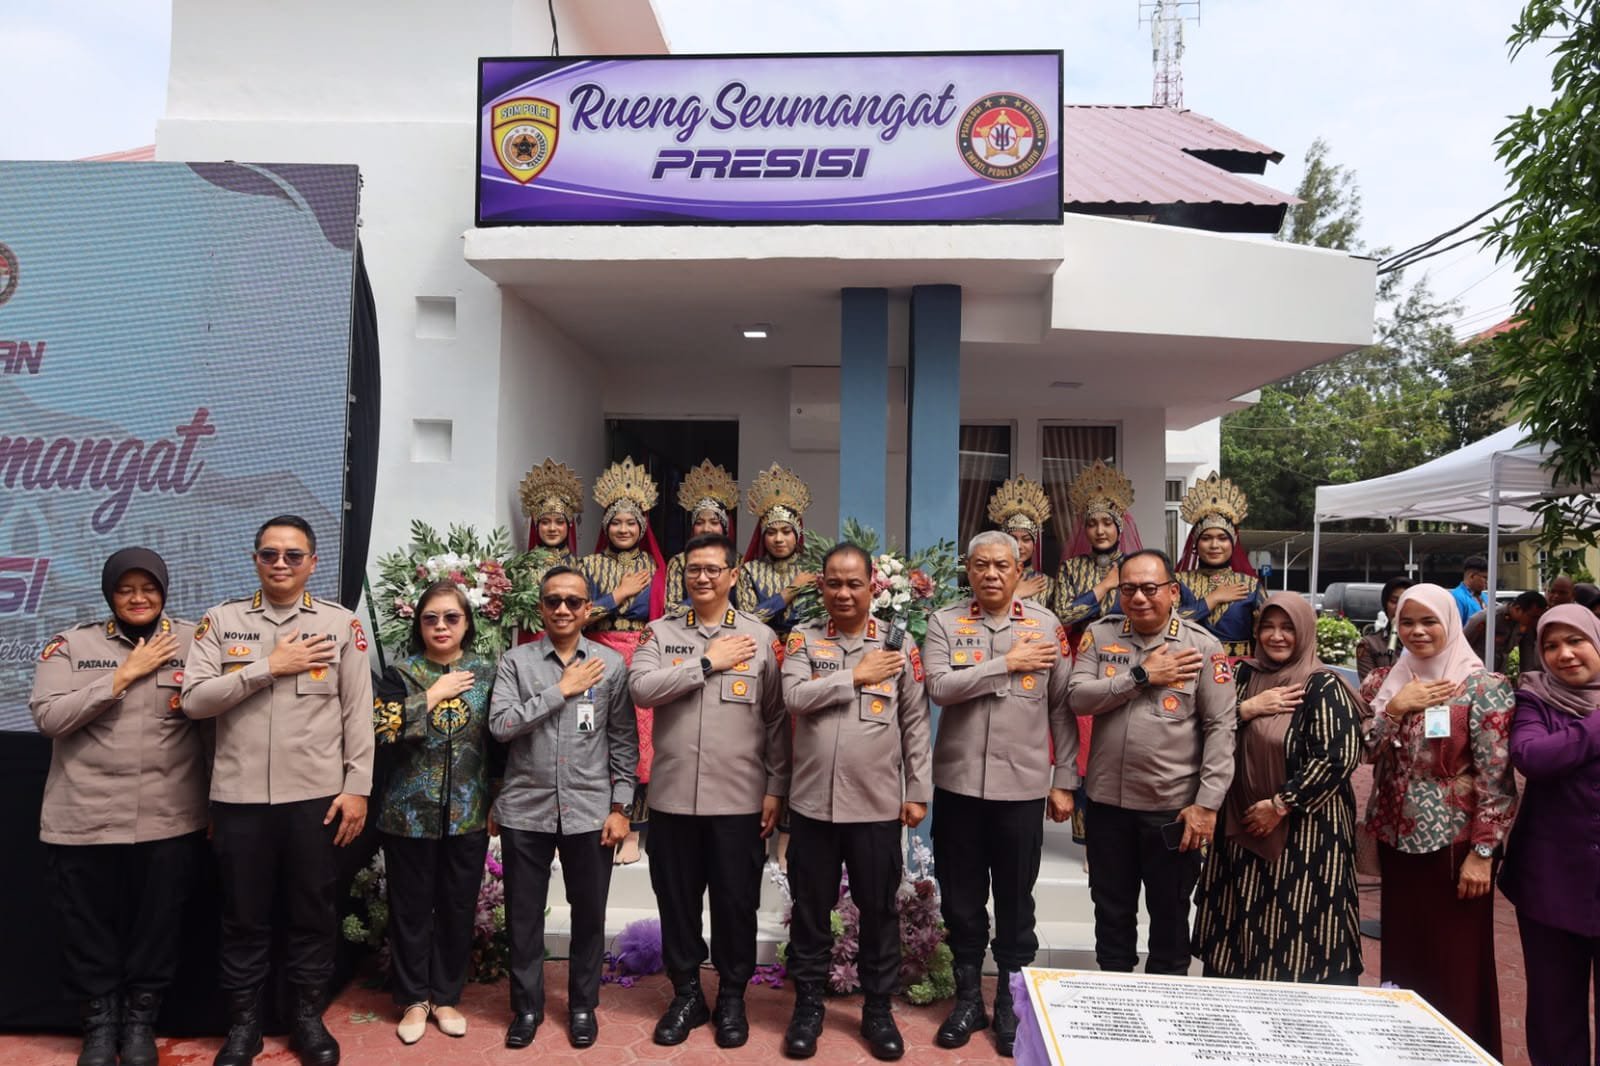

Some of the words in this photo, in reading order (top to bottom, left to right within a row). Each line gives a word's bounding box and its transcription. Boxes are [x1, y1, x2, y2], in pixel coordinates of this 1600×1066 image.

[523, 104, 551, 119] POLRI
[569, 82, 708, 142] Rueng
[710, 82, 957, 142] Seumangat
[651, 147, 870, 179] PRESISI
[223, 631, 260, 641] NOVIAN
[955, 638, 980, 646] ARI
[665, 645, 695, 655] RICKY
[77, 658, 118, 669] PATANA
